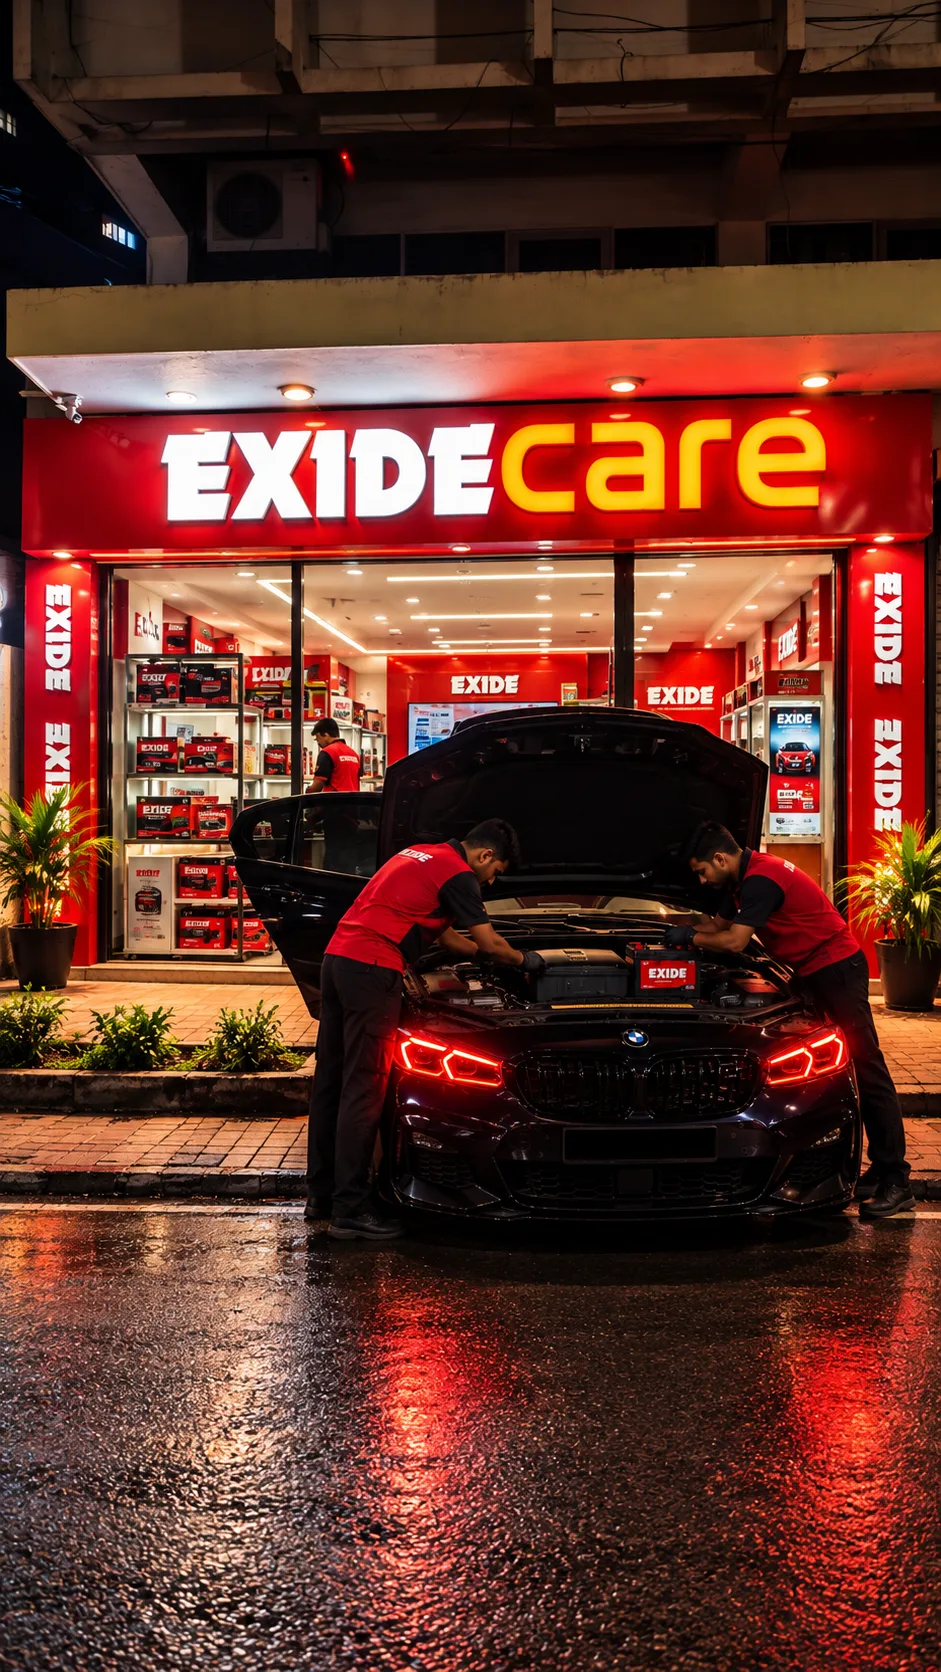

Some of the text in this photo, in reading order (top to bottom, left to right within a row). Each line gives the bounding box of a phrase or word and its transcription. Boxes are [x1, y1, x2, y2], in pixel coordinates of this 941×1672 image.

[161, 417, 827, 522] EXIDE care
[45, 583, 72, 692] EXIDE
[874, 571, 903, 685] EXIDE
[451, 674, 520, 695] EXIDE
[647, 686, 715, 705] EXIDE
[777, 713, 813, 724] EXIDE
[648, 967, 687, 979] EXIDE
